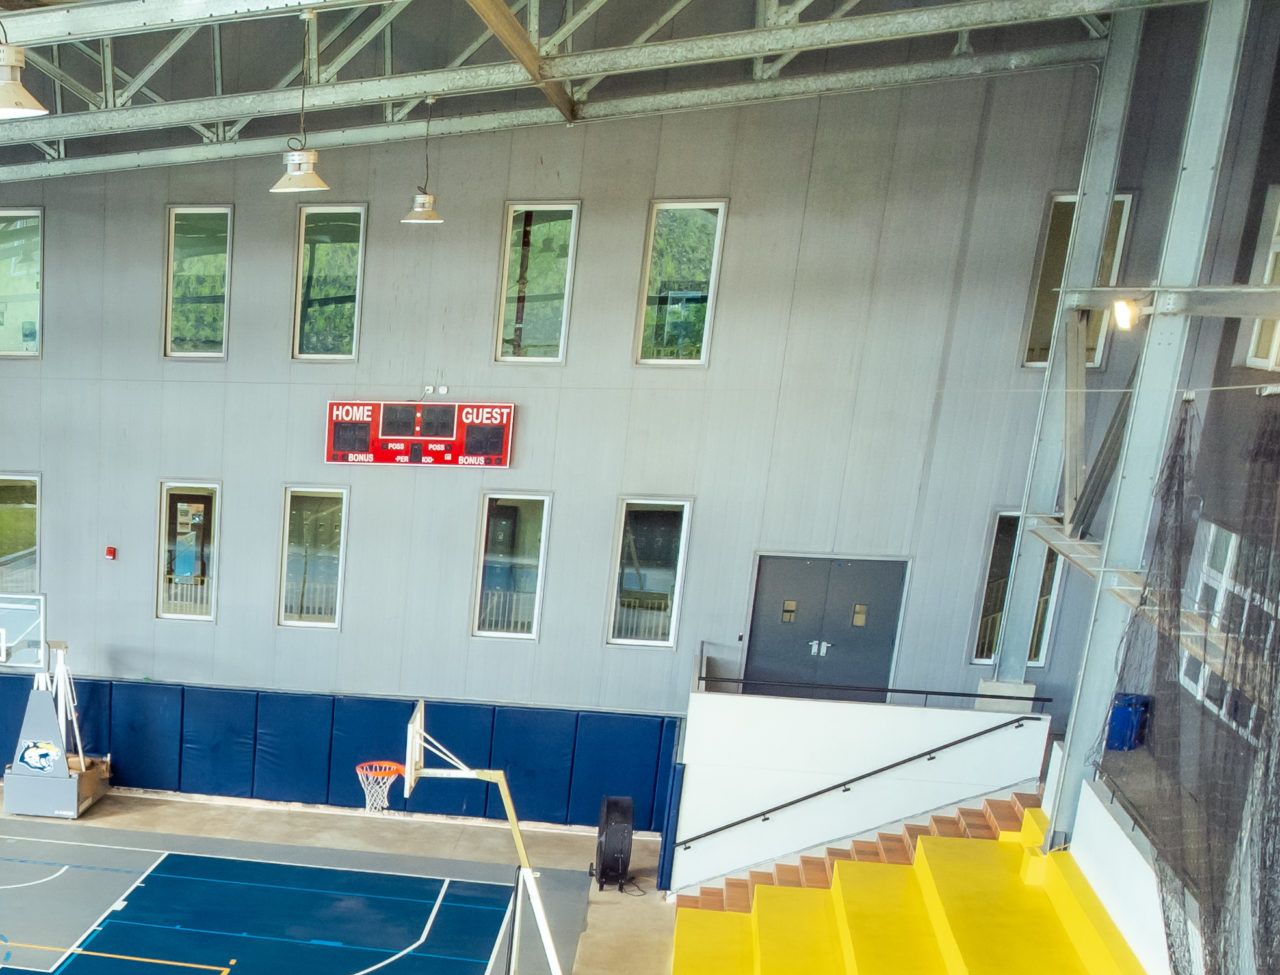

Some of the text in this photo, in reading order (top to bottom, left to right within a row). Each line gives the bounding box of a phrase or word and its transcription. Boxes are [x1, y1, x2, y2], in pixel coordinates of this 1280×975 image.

[333, 405, 372, 421] HOME
[462, 408, 510, 424] GUEST
[388, 442, 404, 450] POSS
[428, 443, 445, 451] POSS
[348, 453, 374, 462] BONUS
[458, 456, 485, 465] BONUS
